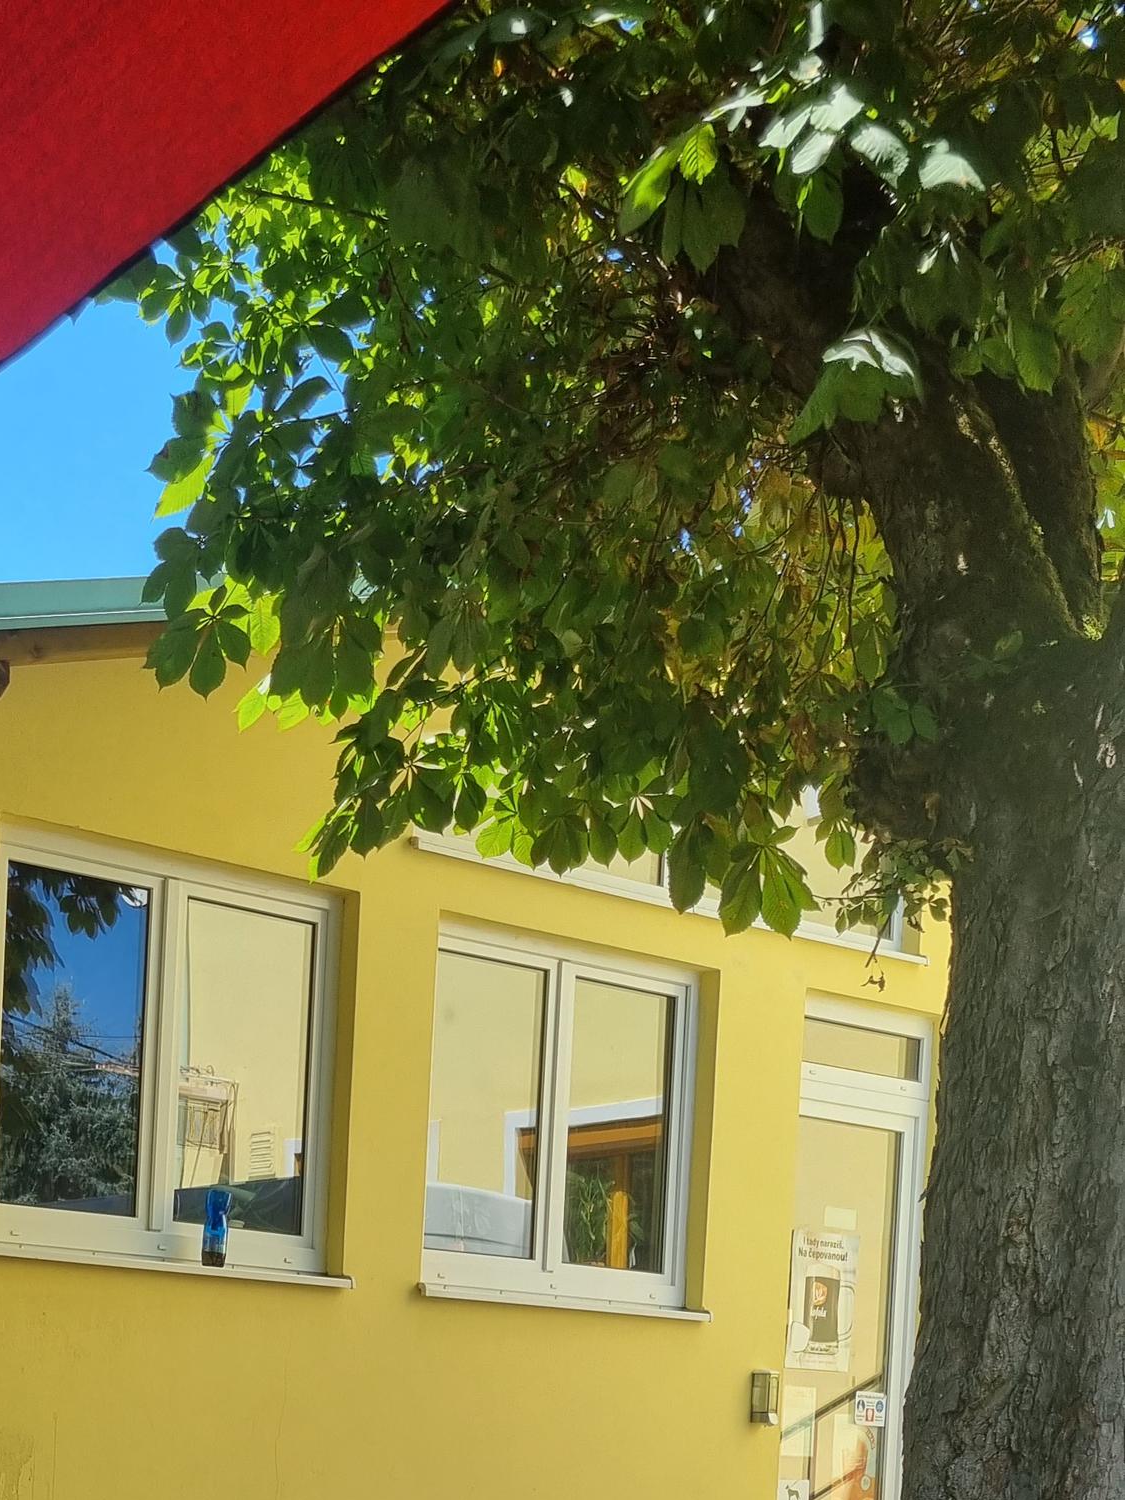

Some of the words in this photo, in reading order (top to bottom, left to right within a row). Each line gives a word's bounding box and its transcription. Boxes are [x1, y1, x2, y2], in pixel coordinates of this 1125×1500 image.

[807, 1237, 819, 1248] tady
[798, 1247, 808, 1258] Na
[808, 1247, 848, 1262] čepovanou!
